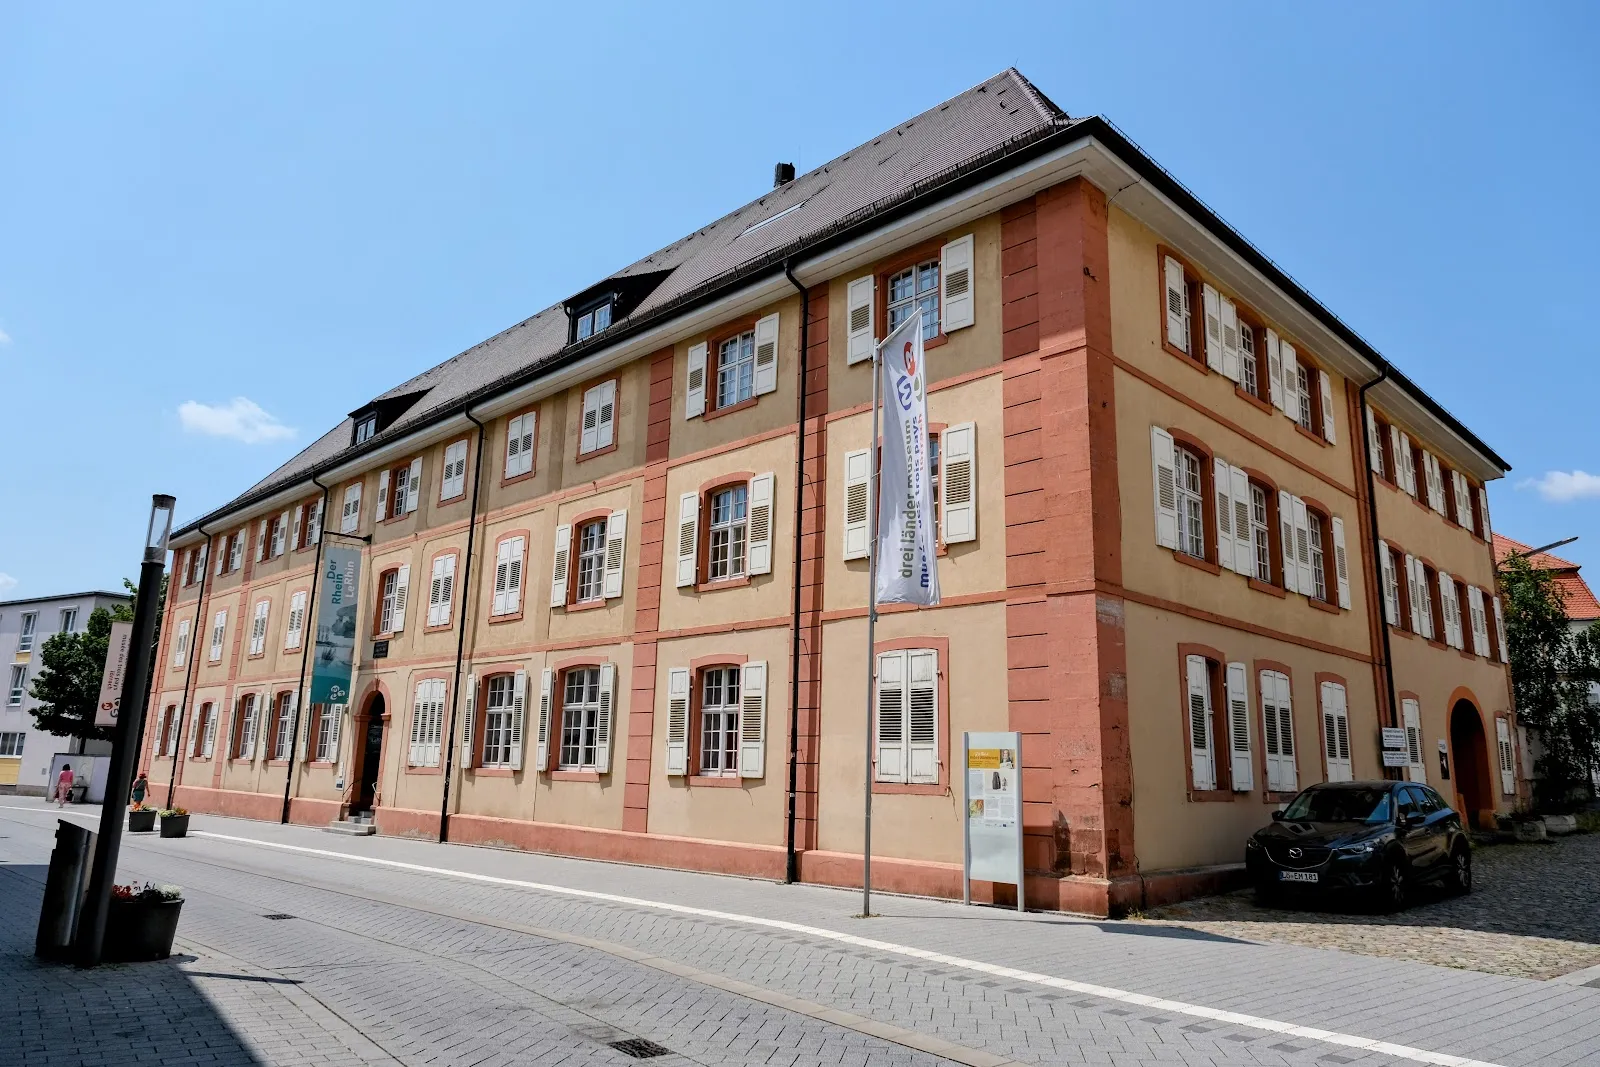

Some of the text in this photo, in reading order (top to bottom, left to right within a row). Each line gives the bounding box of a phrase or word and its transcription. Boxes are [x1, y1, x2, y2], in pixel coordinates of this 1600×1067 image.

[898, 419, 917, 578] drei länder museum
[327, 559, 337, 579] Der
[331, 573, 344, 605] Rhein
